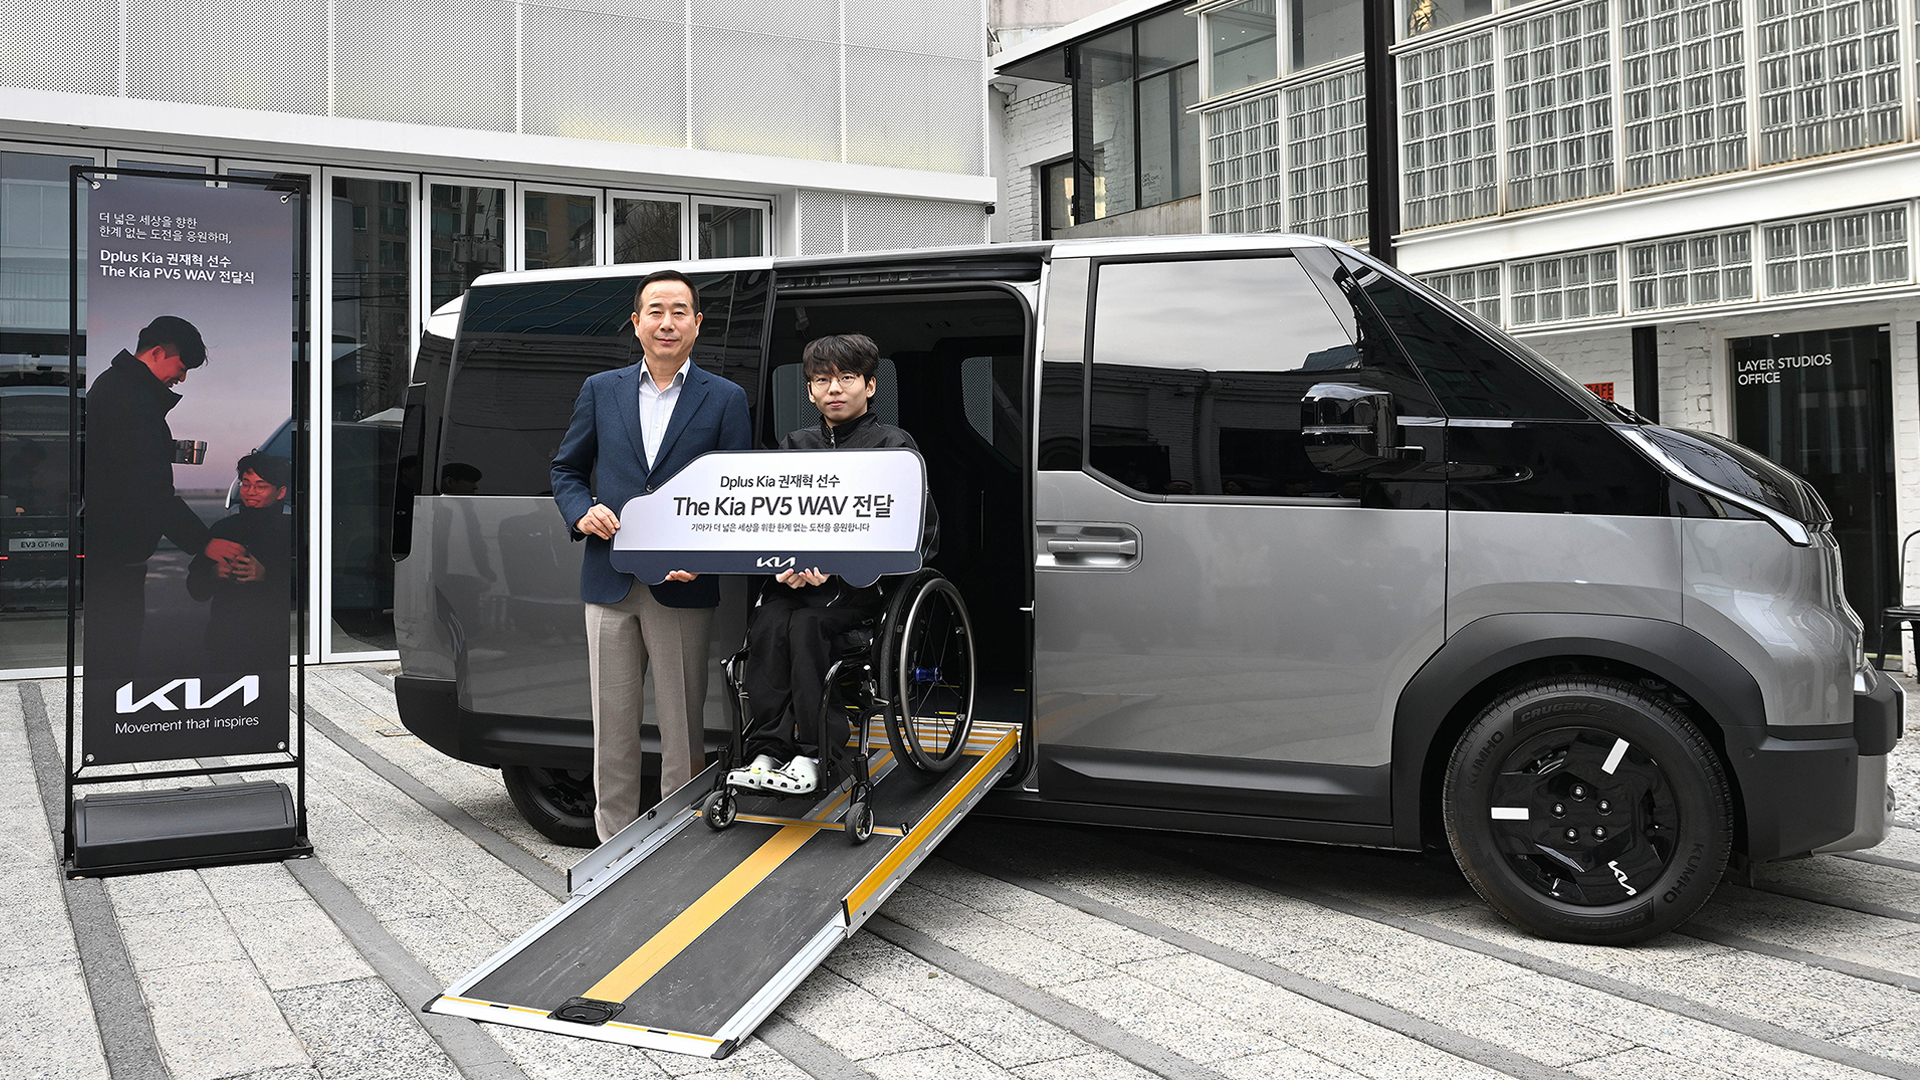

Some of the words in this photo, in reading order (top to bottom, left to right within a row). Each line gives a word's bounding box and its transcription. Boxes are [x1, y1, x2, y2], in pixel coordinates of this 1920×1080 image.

[99, 212, 110, 224] 더
[114, 213, 136, 226] 넓은
[139, 214, 173, 228] 세상을
[175, 217, 198, 230] 향한
[99, 225, 122, 238] 한계
[124, 227, 147, 240] 없는
[150, 228, 183, 242] 도전을
[186, 231, 232, 244] 응원하며,
[100, 249, 139, 264] Dplus
[142, 251, 163, 264] Kia
[166, 252, 203, 267] 권재혁
[207, 254, 232, 268] 선수
[100, 264, 126, 277] The
[129, 266, 151, 278] Kia
[154, 267, 181, 280] PV5
[184, 269, 216, 281] WAV
[219, 271, 255, 285] 전달식
[1737, 358, 1775, 373] LAYER
[1778, 353, 1833, 369] STUDIOS
[1737, 372, 1781, 386] OFFICE
[720, 475, 754, 491] Dplus
[756, 475, 776, 488] Kia
[778, 474, 814, 489] 권재혁
[816, 474, 841, 488] 선수
[673, 496, 710, 516] The
[714, 495, 746, 516] Kia
[750, 495, 793, 516] PV5
[798, 495, 849, 515] WAV
[852, 493, 895, 519] 전달
[691, 522, 712, 533] 기아가
[714, 522, 721, 533] 더
[738, 522, 759, 533] 세상을
[761, 522, 776, 533] 위한
[777, 522, 792, 533] 한계
[793, 522, 808, 533] 없는
[809, 522, 831, 533] 도전을
[833, 522, 870, 533] 응원합니다
[38, 540, 65, 548] GT-line
[756, 556, 796, 568] KIA
[116, 675, 259, 714] KIA
[1520, 702, 1587, 722] CRUGEN
[115, 718, 182, 734] Movement
[186, 717, 210, 730] that
[214, 715, 259, 729] inspires
[1466, 730, 1505, 791] KUMHO
[1608, 860, 1638, 896] KIA
[1662, 842, 1704, 904] KUMHO
